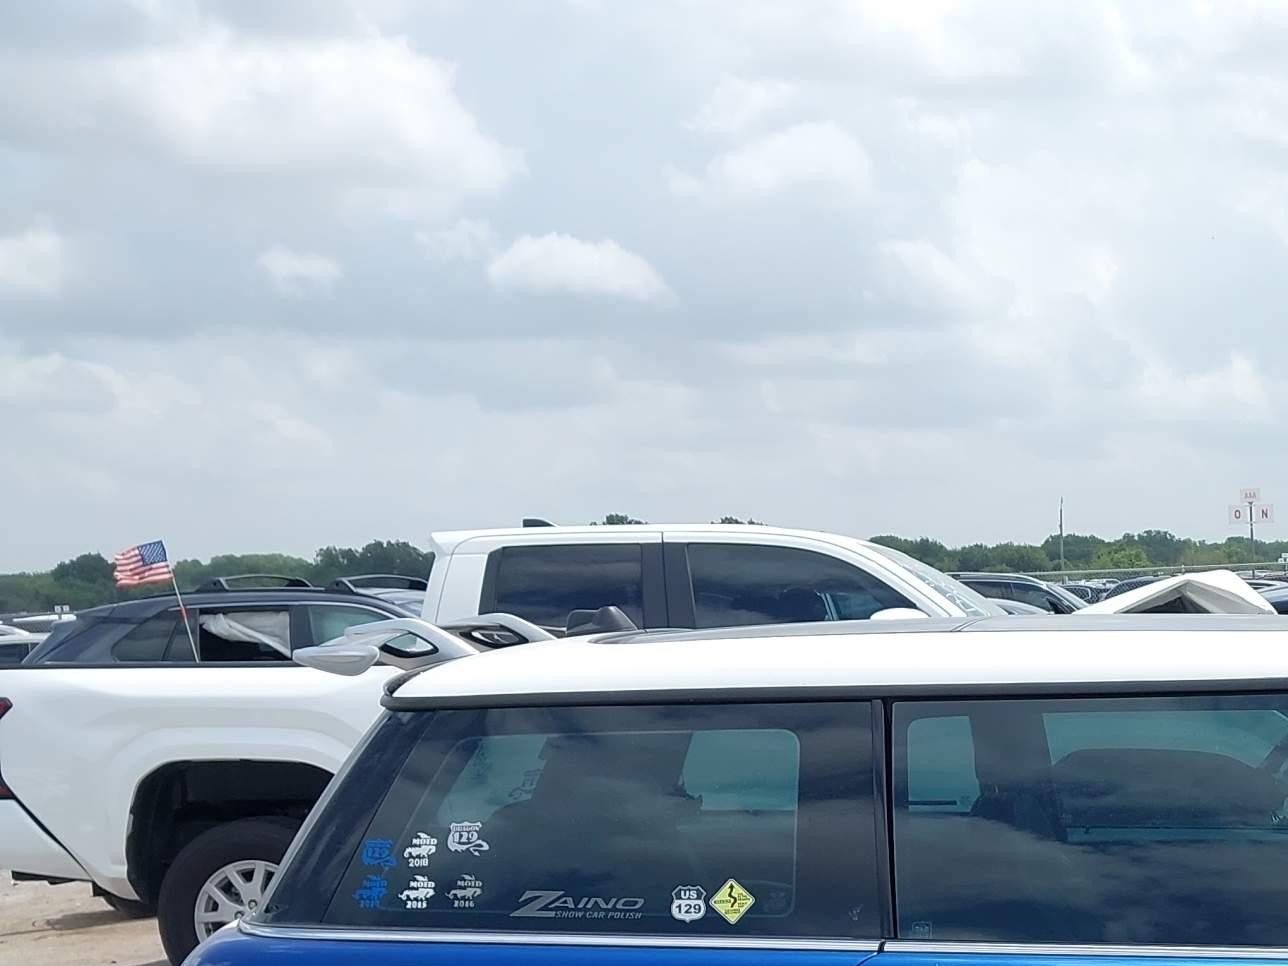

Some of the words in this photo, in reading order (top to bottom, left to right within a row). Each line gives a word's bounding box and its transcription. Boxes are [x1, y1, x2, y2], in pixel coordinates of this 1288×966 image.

[1261, 507, 1269, 520] N
[453, 831, 479, 843] 129
[680, 889, 698, 900] US
[509, 890, 645, 917] ZAINO
[675, 903, 702, 914] 129
[555, 910, 584, 919] SHOW
[586, 911, 605, 919] CAR
[607, 911, 643, 920] POLISH
